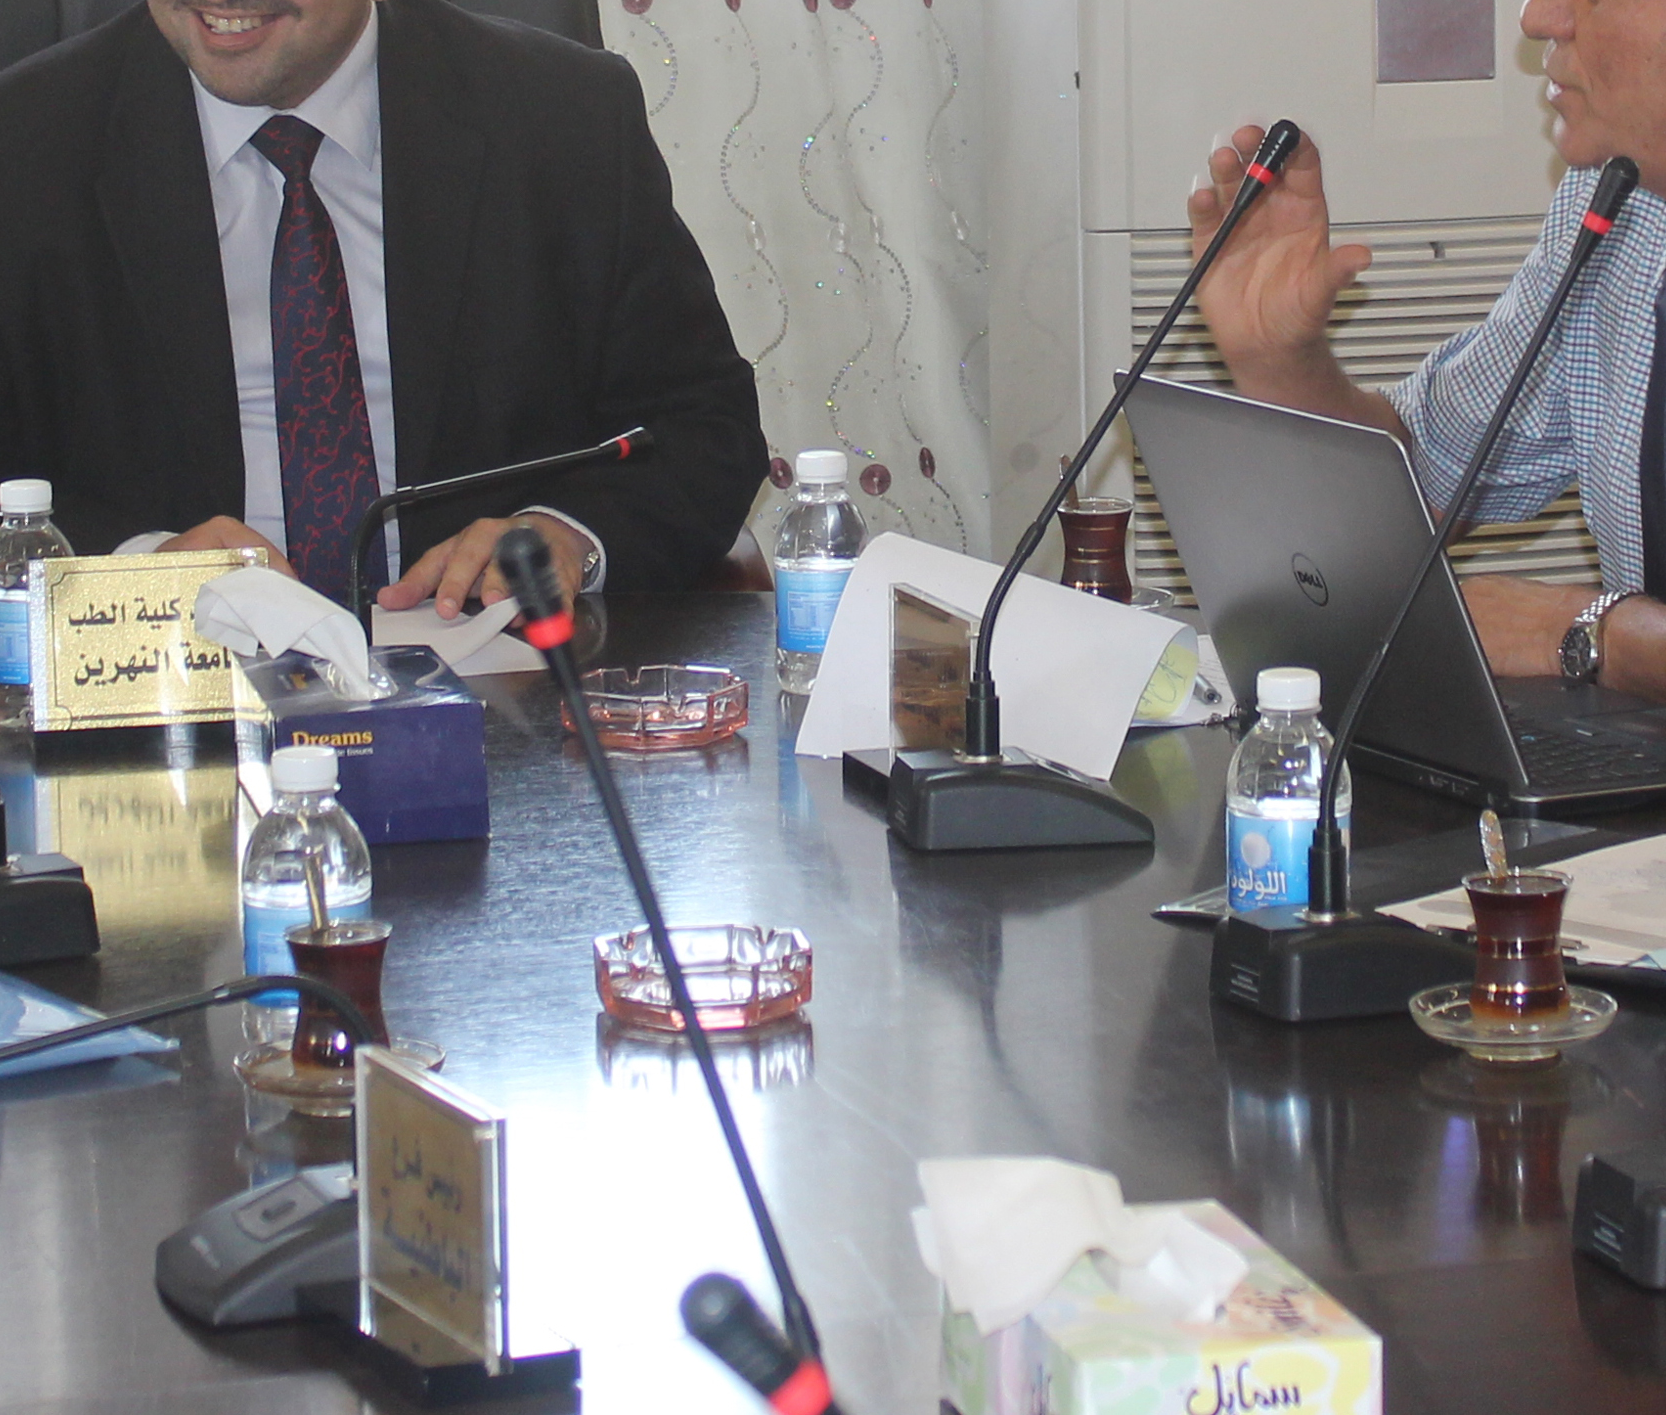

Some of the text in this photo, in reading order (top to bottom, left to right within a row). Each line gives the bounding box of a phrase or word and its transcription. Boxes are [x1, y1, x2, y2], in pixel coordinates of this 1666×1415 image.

[1297, 571, 1324, 588] DELL
[68, 602, 126, 633] الطب
[134, 596, 181, 629] كلية
[74, 641, 232, 686] امعة النهرين
[292, 730, 374, 746] Dreams
